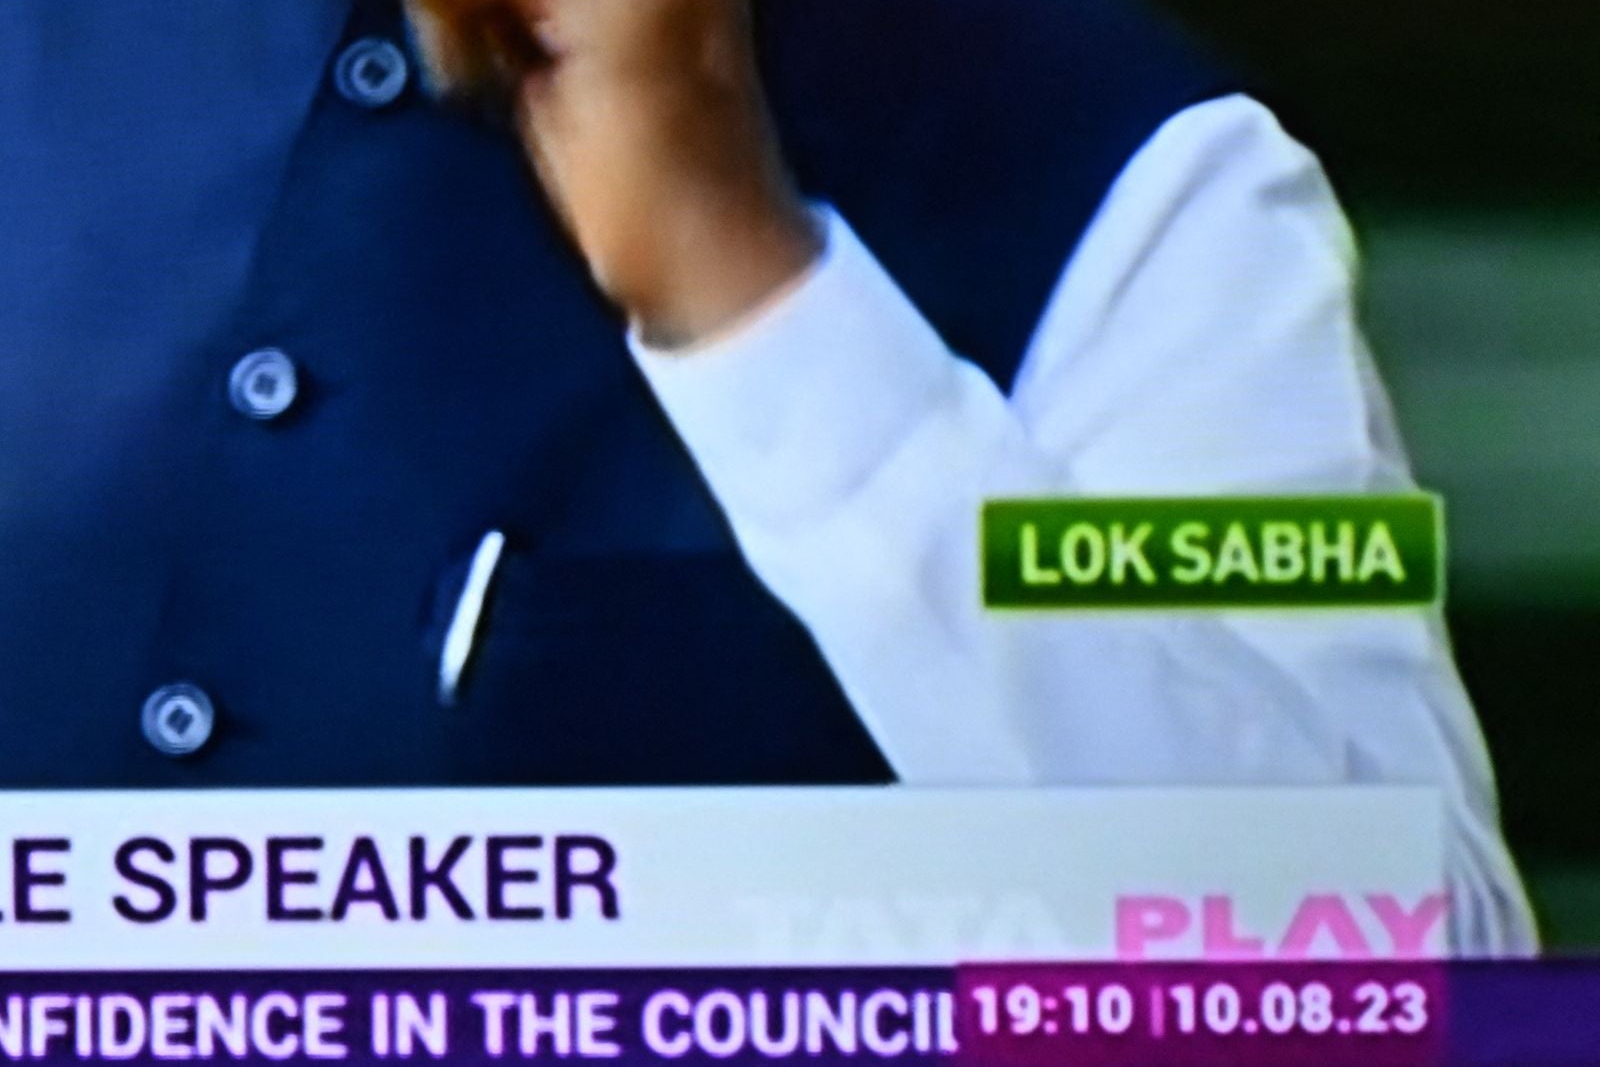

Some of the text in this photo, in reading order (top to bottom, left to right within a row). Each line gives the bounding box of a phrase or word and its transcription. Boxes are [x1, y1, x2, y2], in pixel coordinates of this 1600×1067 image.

[1019, 519, 1406, 585] LOK SABHA
[112, 834, 621, 924] SPEAKER
[1113, 893, 1450, 962] PLAY
[372, 994, 447, 1057] IN
[474, 992, 620, 1057] THE
[973, 984, 1133, 1034] 19:10
